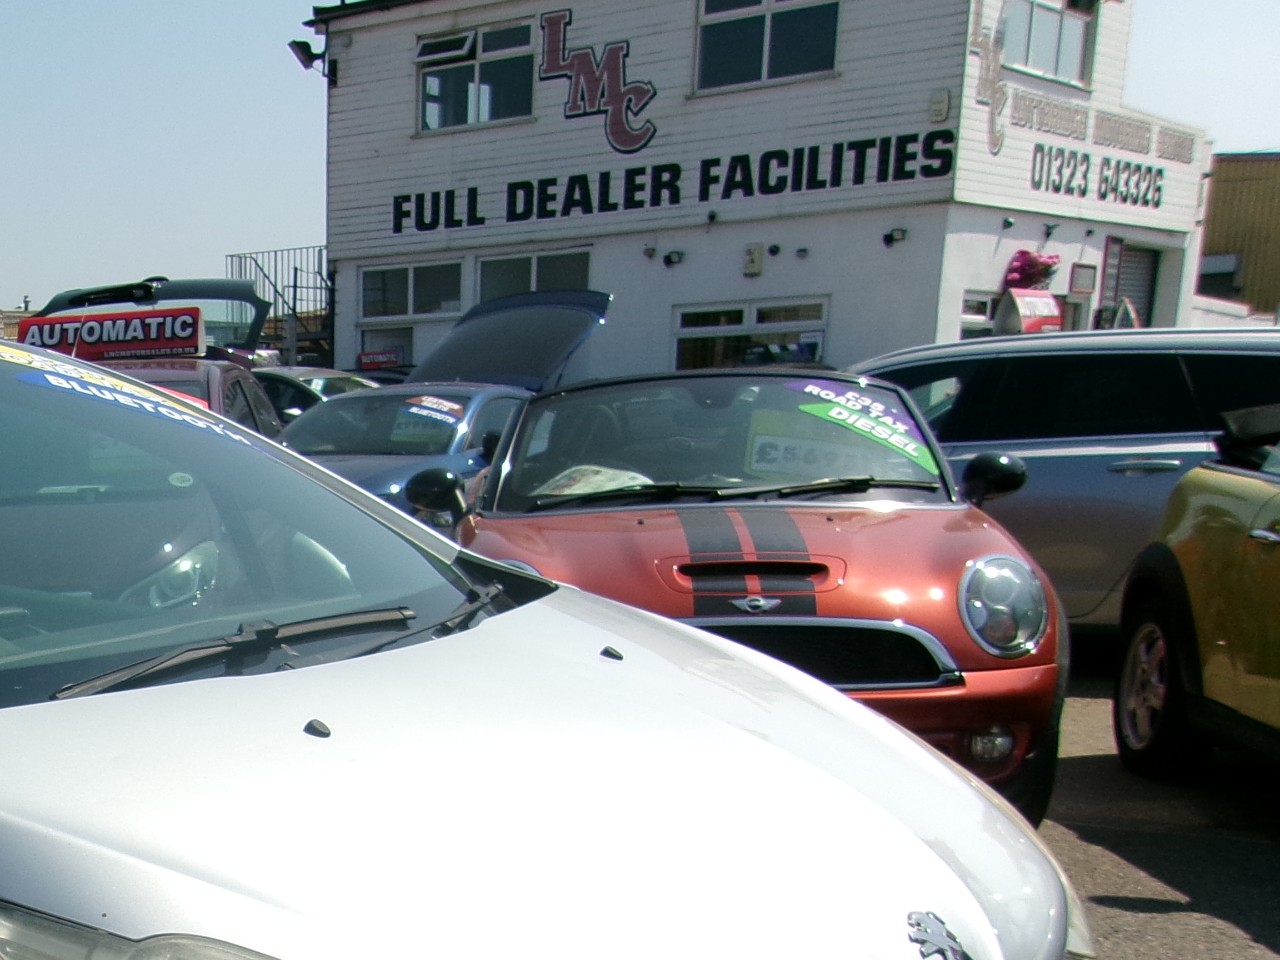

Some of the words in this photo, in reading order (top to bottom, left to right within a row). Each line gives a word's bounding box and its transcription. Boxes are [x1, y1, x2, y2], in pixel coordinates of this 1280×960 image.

[540, 9, 657, 154] LMC
[392, 187, 486, 234] FULL
[506, 163, 682, 223] DEALER
[698, 129, 955, 202] FACILITIES
[1031, 142, 1091, 198] 01323
[1097, 157, 1166, 209] 643326
[23, 315, 194, 347] AUTOMATIC
[803, 384, 864, 411] ROAD
[869, 408, 909, 434] TAX
[827, 406, 919, 457] DIESEL
